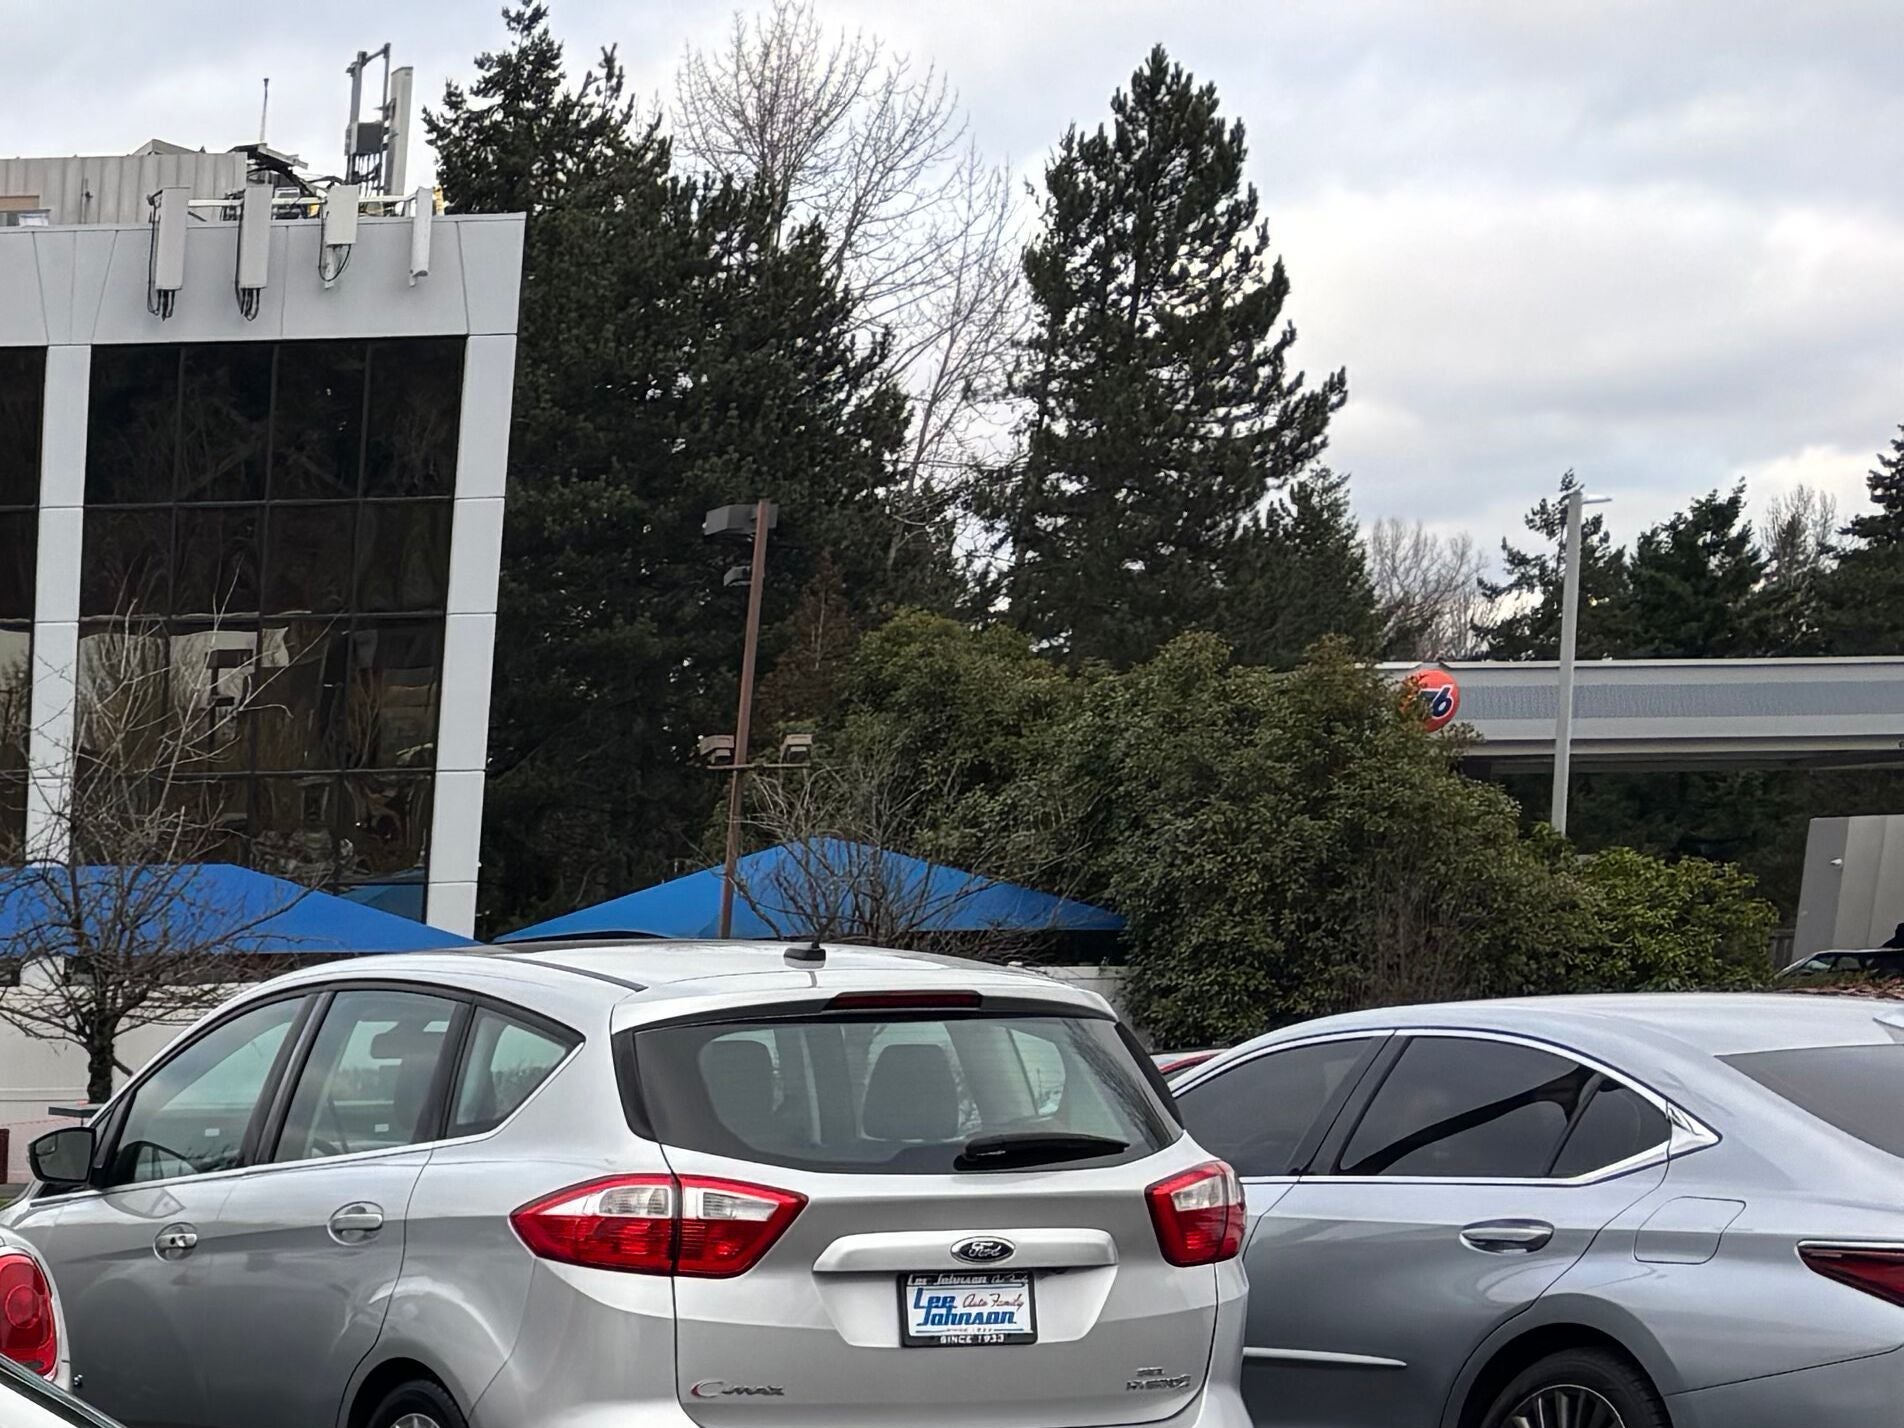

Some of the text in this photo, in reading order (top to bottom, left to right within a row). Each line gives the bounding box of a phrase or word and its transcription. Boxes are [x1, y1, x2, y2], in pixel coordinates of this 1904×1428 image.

[968, 1242, 1002, 1257] Ford
[913, 1288, 958, 1309] Lee
[916, 1305, 1017, 1326] Johnson
[940, 1333, 1005, 1344] SINCE 1933
